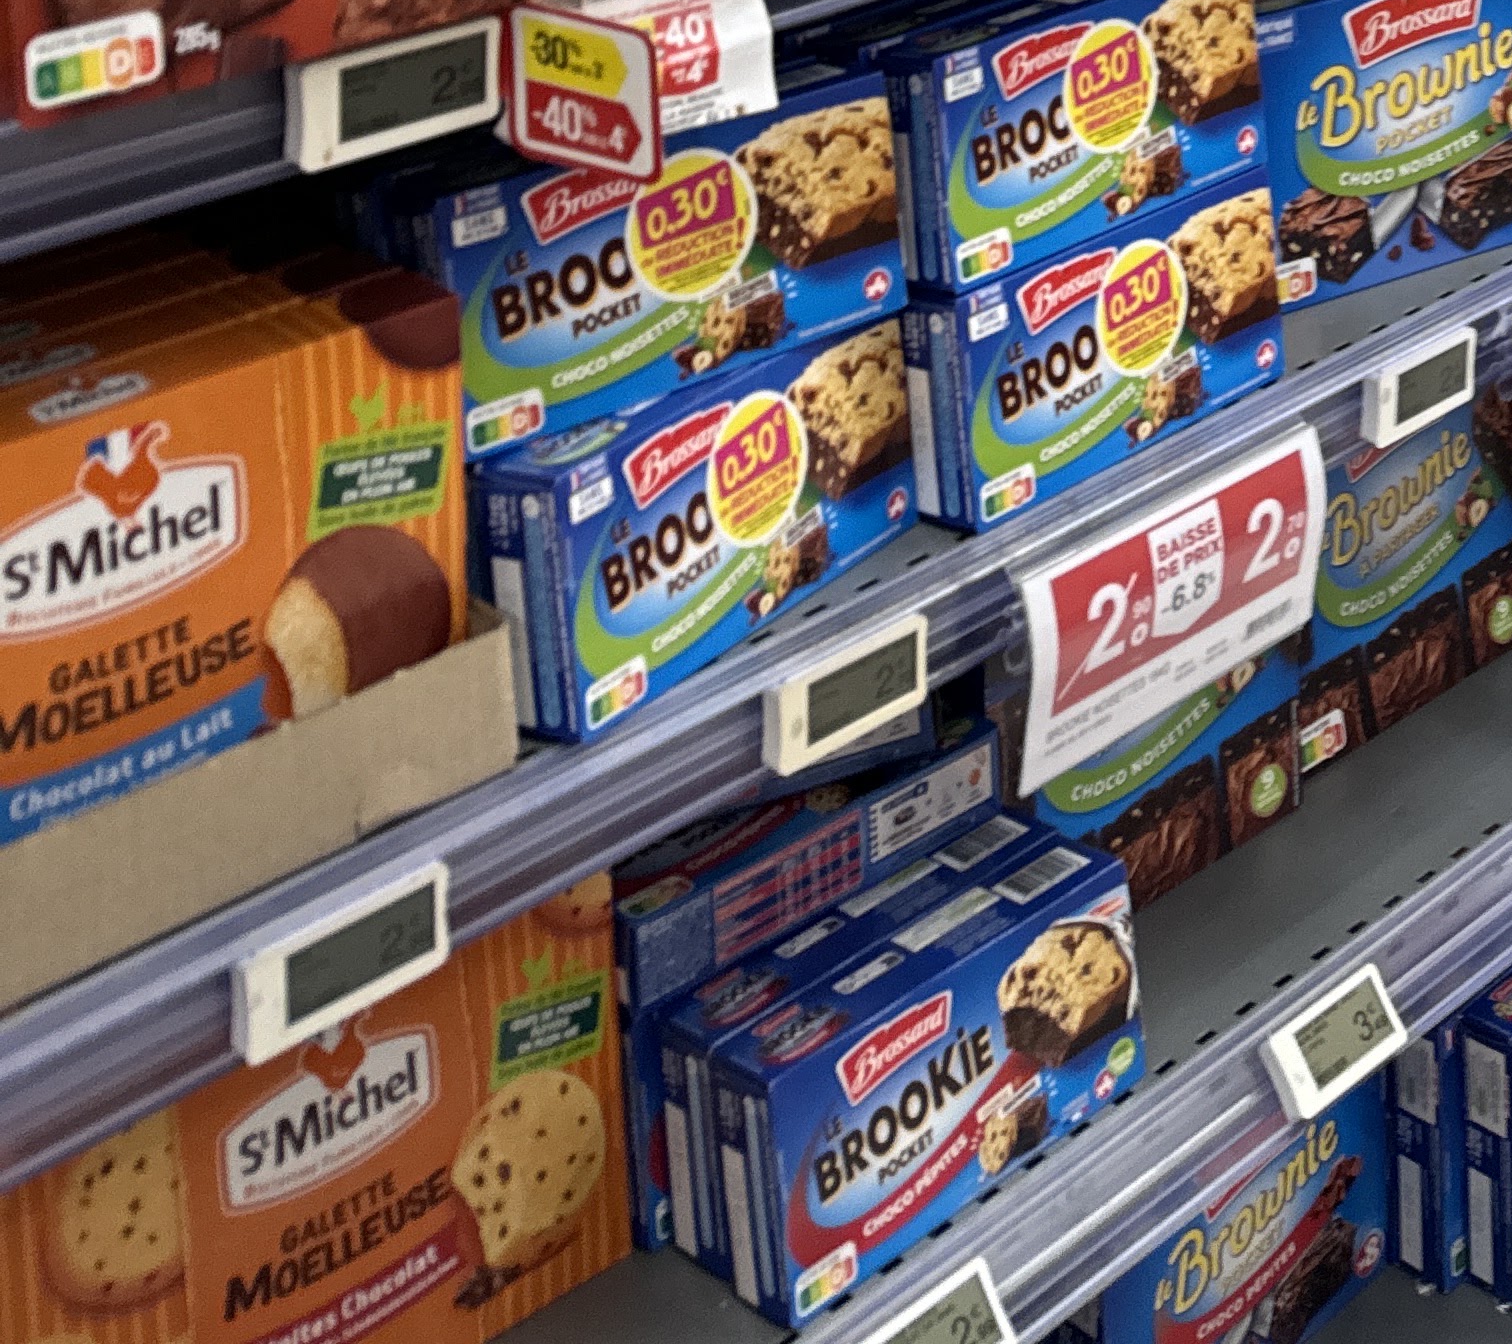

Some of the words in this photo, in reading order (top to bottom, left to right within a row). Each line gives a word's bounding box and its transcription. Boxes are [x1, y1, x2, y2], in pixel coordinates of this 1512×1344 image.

[1028, 144, 1079, 183] POCKET
[1337, 165, 1395, 188] CHOCO
[1397, 130, 1481, 177] NOISETTES
[1374, 106, 1454, 155] POCKET
[571, 293, 642, 339] POCKET
[552, 356, 608, 390] CHOCO
[1054, 373, 1104, 415] POCKET
[1328, 429, 1472, 568] Brownie
[44, 484, 223, 596] Michel
[666, 549, 721, 599] POCKET
[1156, 516, 1218, 565] BAISSE
[1156, 563, 1181, 585] DE
[1182, 539, 1224, 577] PRIX
[1242, 497, 1286, 584] 2
[0, 619, 258, 756] MOELLEUSE
[47, 615, 192, 694] GALETTE
[9, 752, 135, 821] Chocolat
[140, 736, 176, 769] au
[180, 706, 235, 753] Lait
[1071, 767, 1128, 802] CHOCO
[1130, 696, 1211, 777] NOISETTES
[850, 1009, 953, 1090] Brossard
[273, 1051, 420, 1167] Michel
[815, 1021, 996, 1205] BROOKIE
[877, 1133, 935, 1187] POCKET
[223, 1165, 454, 1322] MOELLEUSE
[279, 1169, 397, 1254] GALETTE
[862, 1195, 917, 1238] CHOCO
[1168, 1119, 1339, 1314] Brownie
[340, 1244, 439, 1319] Chocolat
